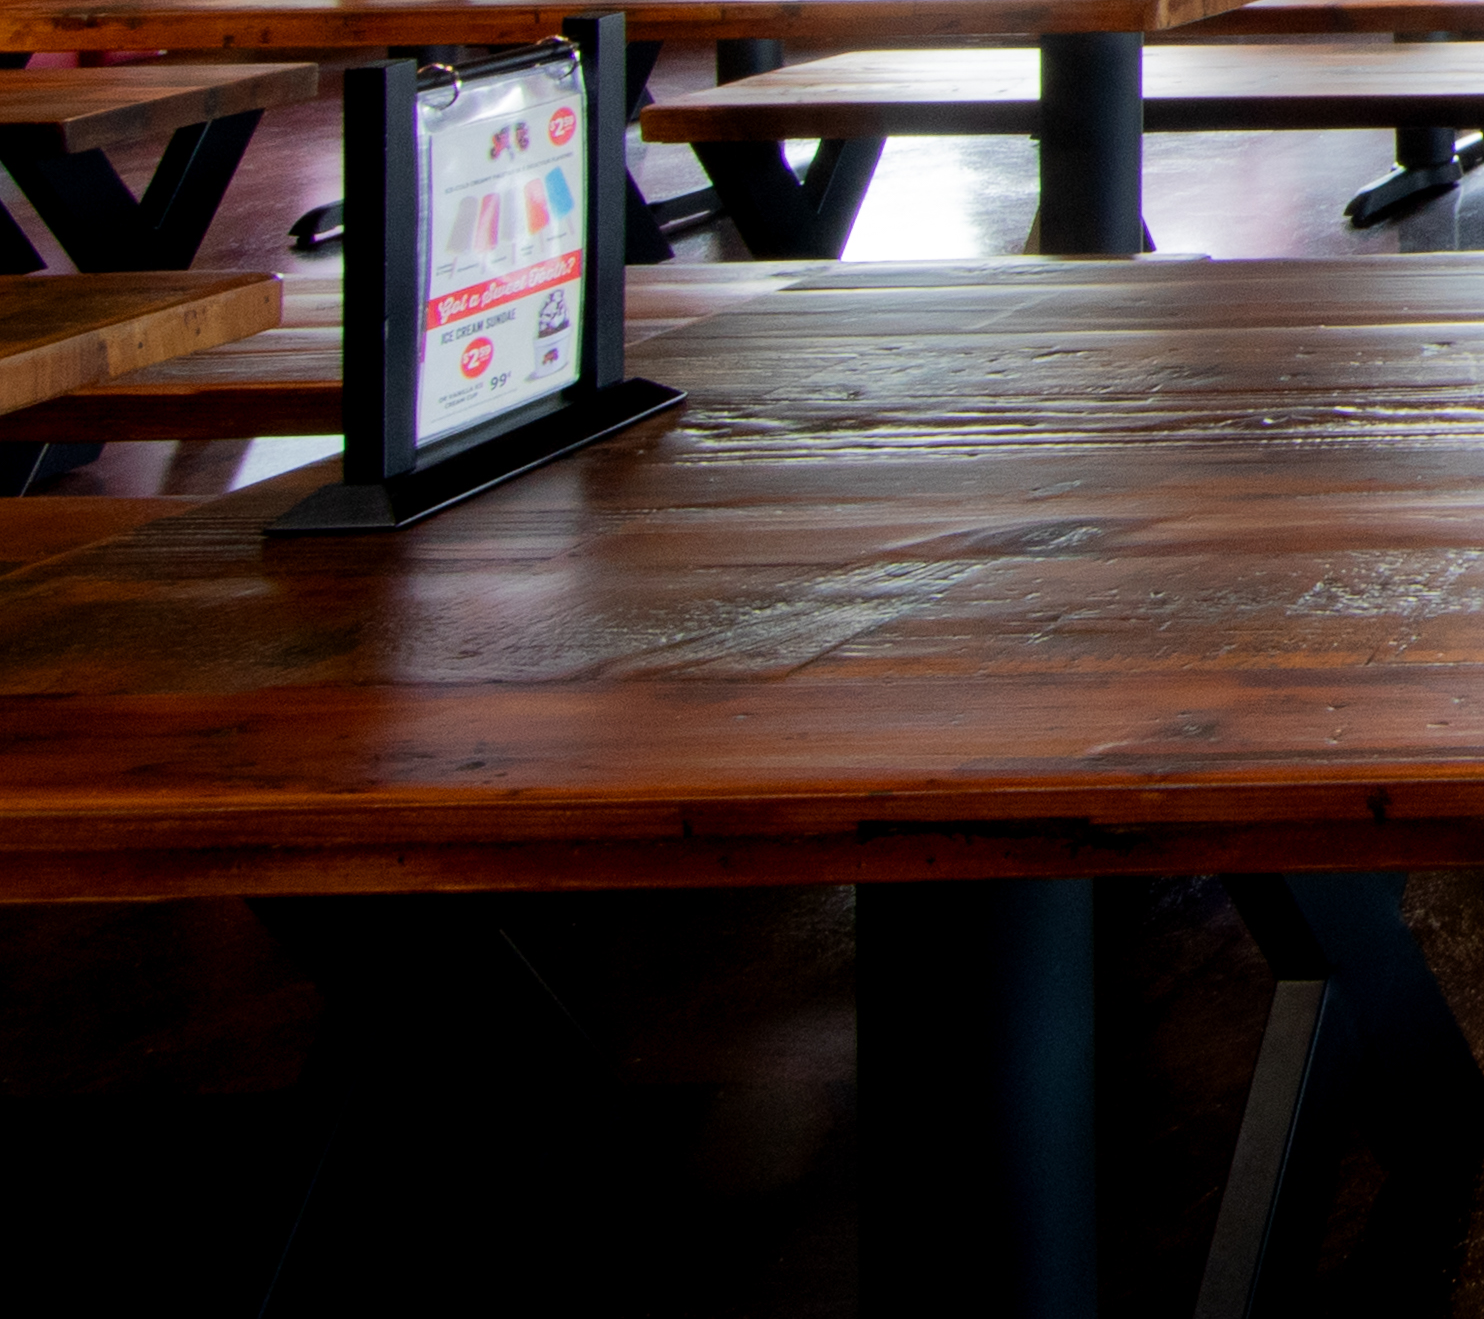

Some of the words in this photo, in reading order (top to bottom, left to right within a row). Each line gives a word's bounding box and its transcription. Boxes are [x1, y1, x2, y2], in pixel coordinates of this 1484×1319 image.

[437, 293, 469, 325] Got
[468, 294, 481, 308] a
[480, 276, 528, 309] Sweet
[440, 329, 455, 346] ICE
[455, 319, 485, 342] CREAM
[485, 307, 518, 331] SUNDAE
